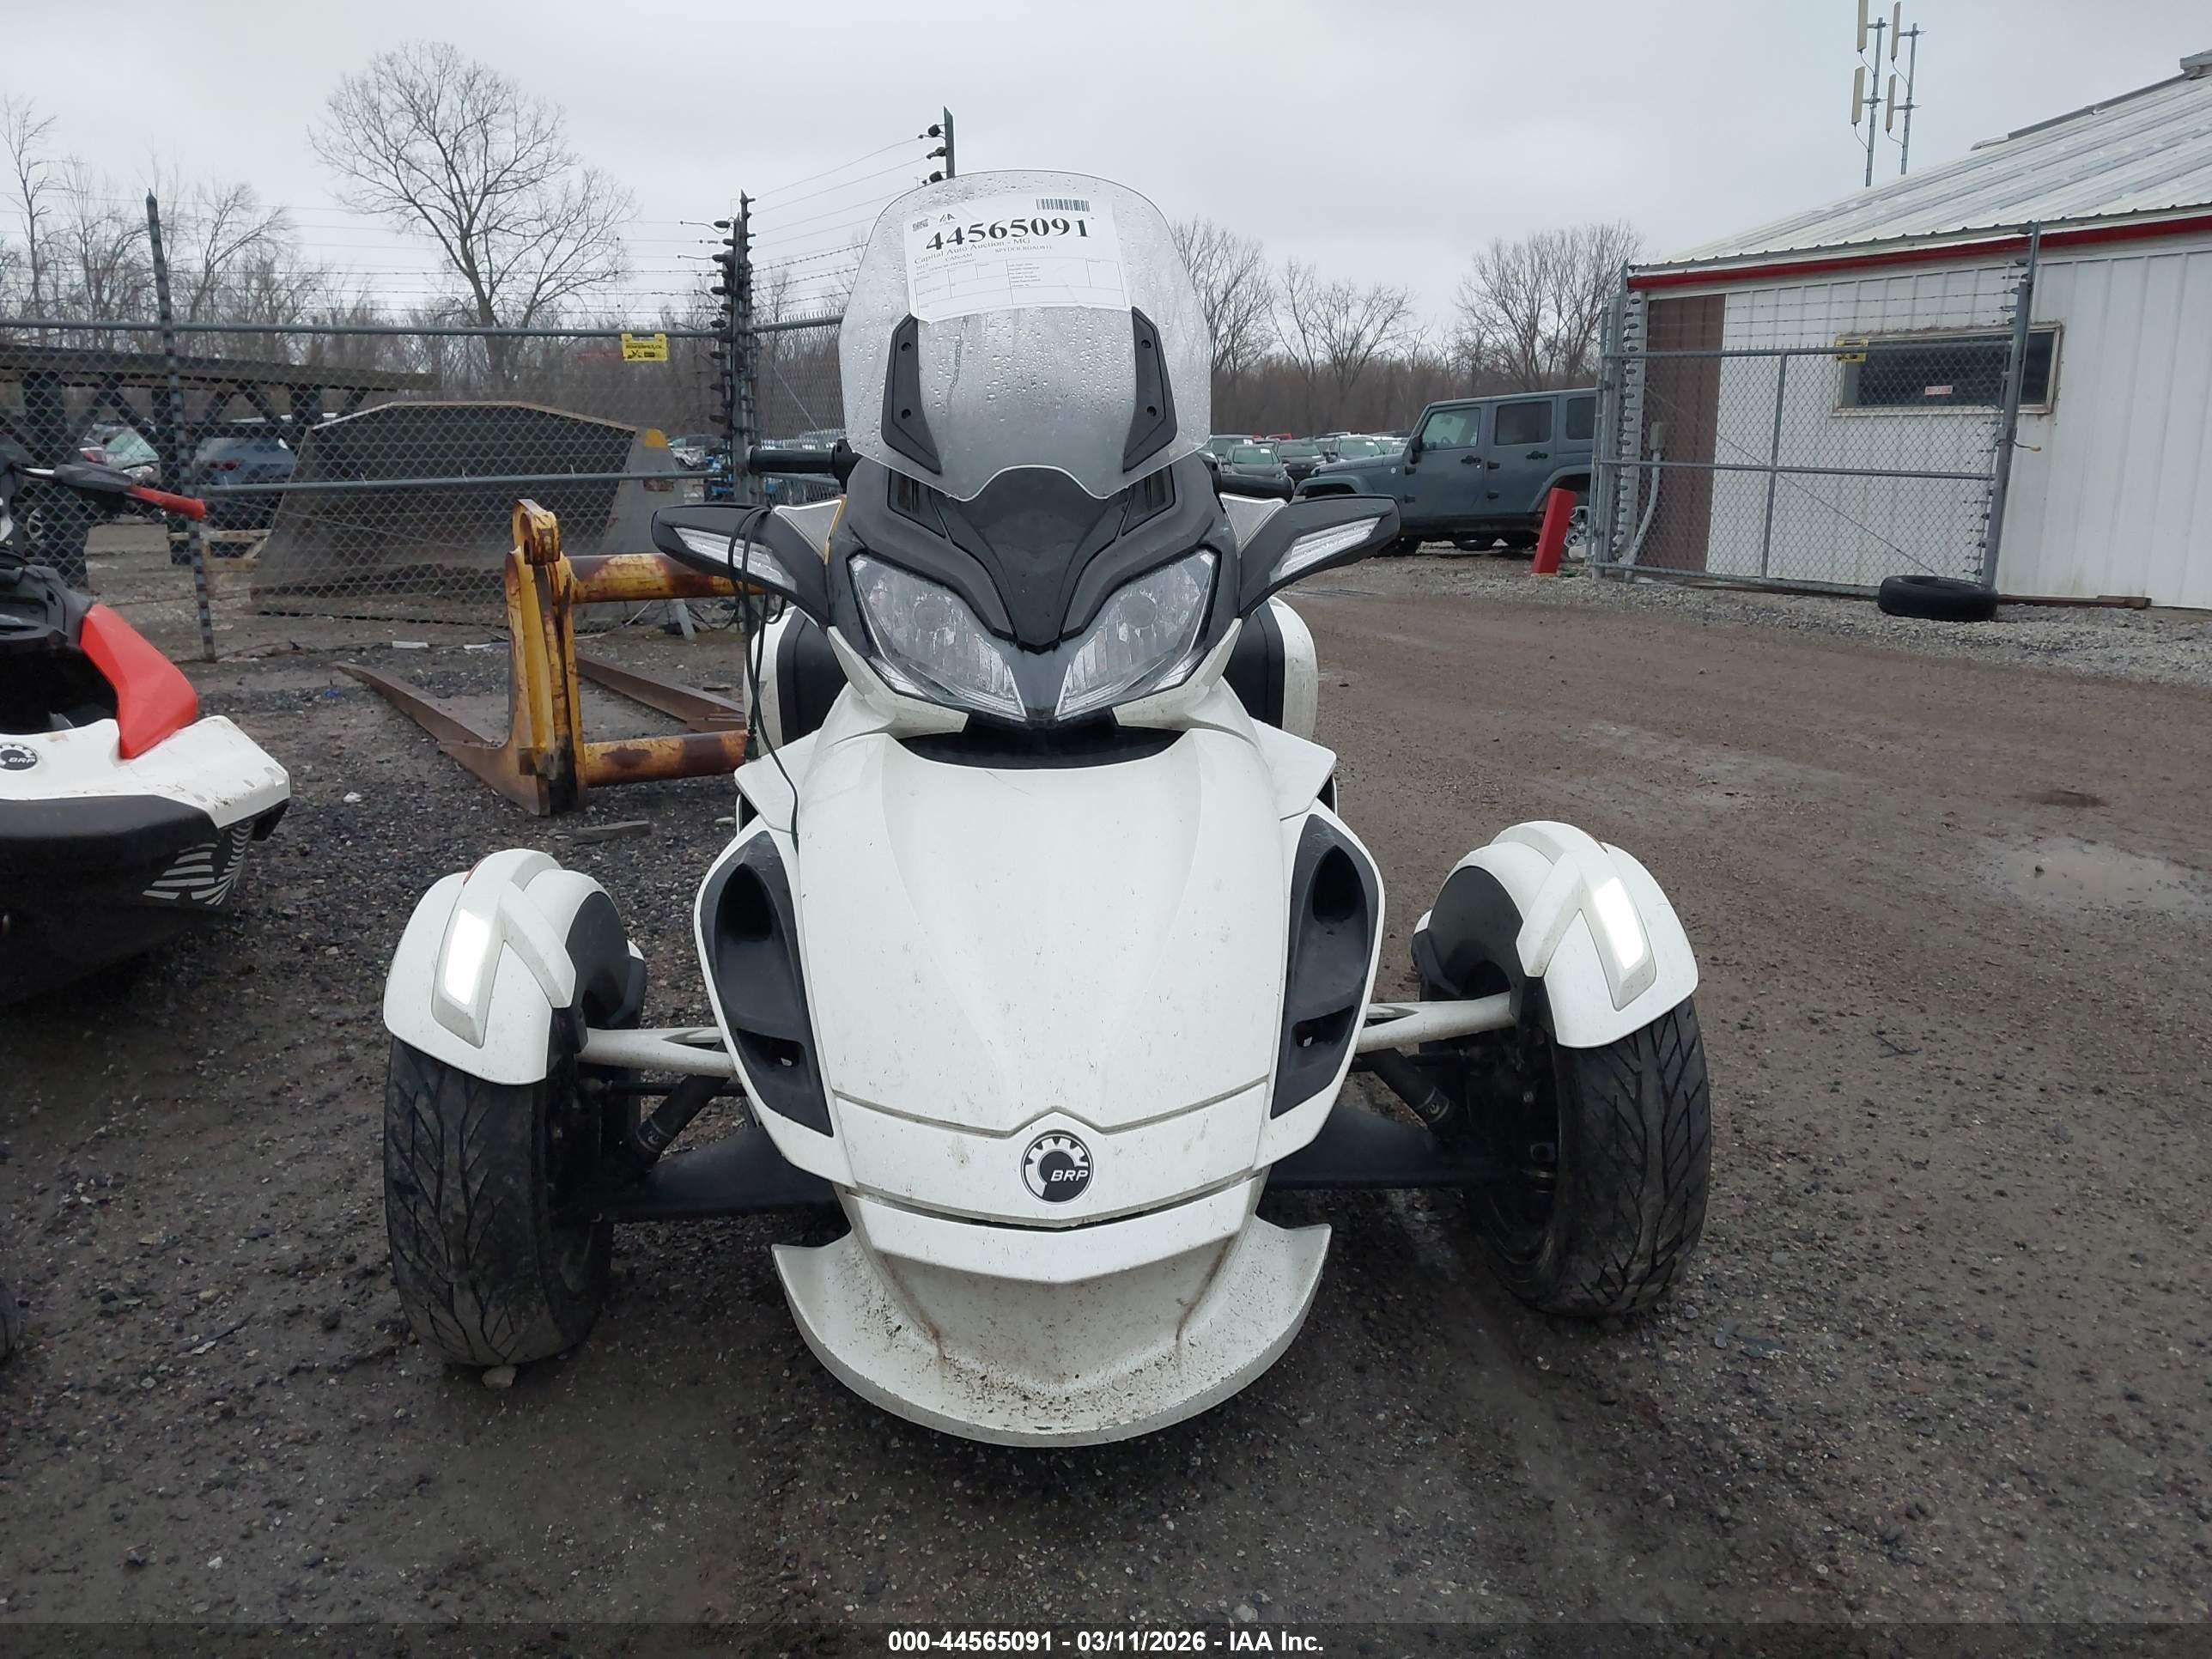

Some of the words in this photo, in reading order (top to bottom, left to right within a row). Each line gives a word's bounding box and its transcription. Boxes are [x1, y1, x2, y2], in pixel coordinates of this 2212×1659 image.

[926, 216, 1091, 251] 44565091
[915, 251, 944, 264] Capital
[946, 246, 967, 256] Auto
[970, 241, 1005, 251] Auction
[1050, 1170, 1089, 1182] BRP
